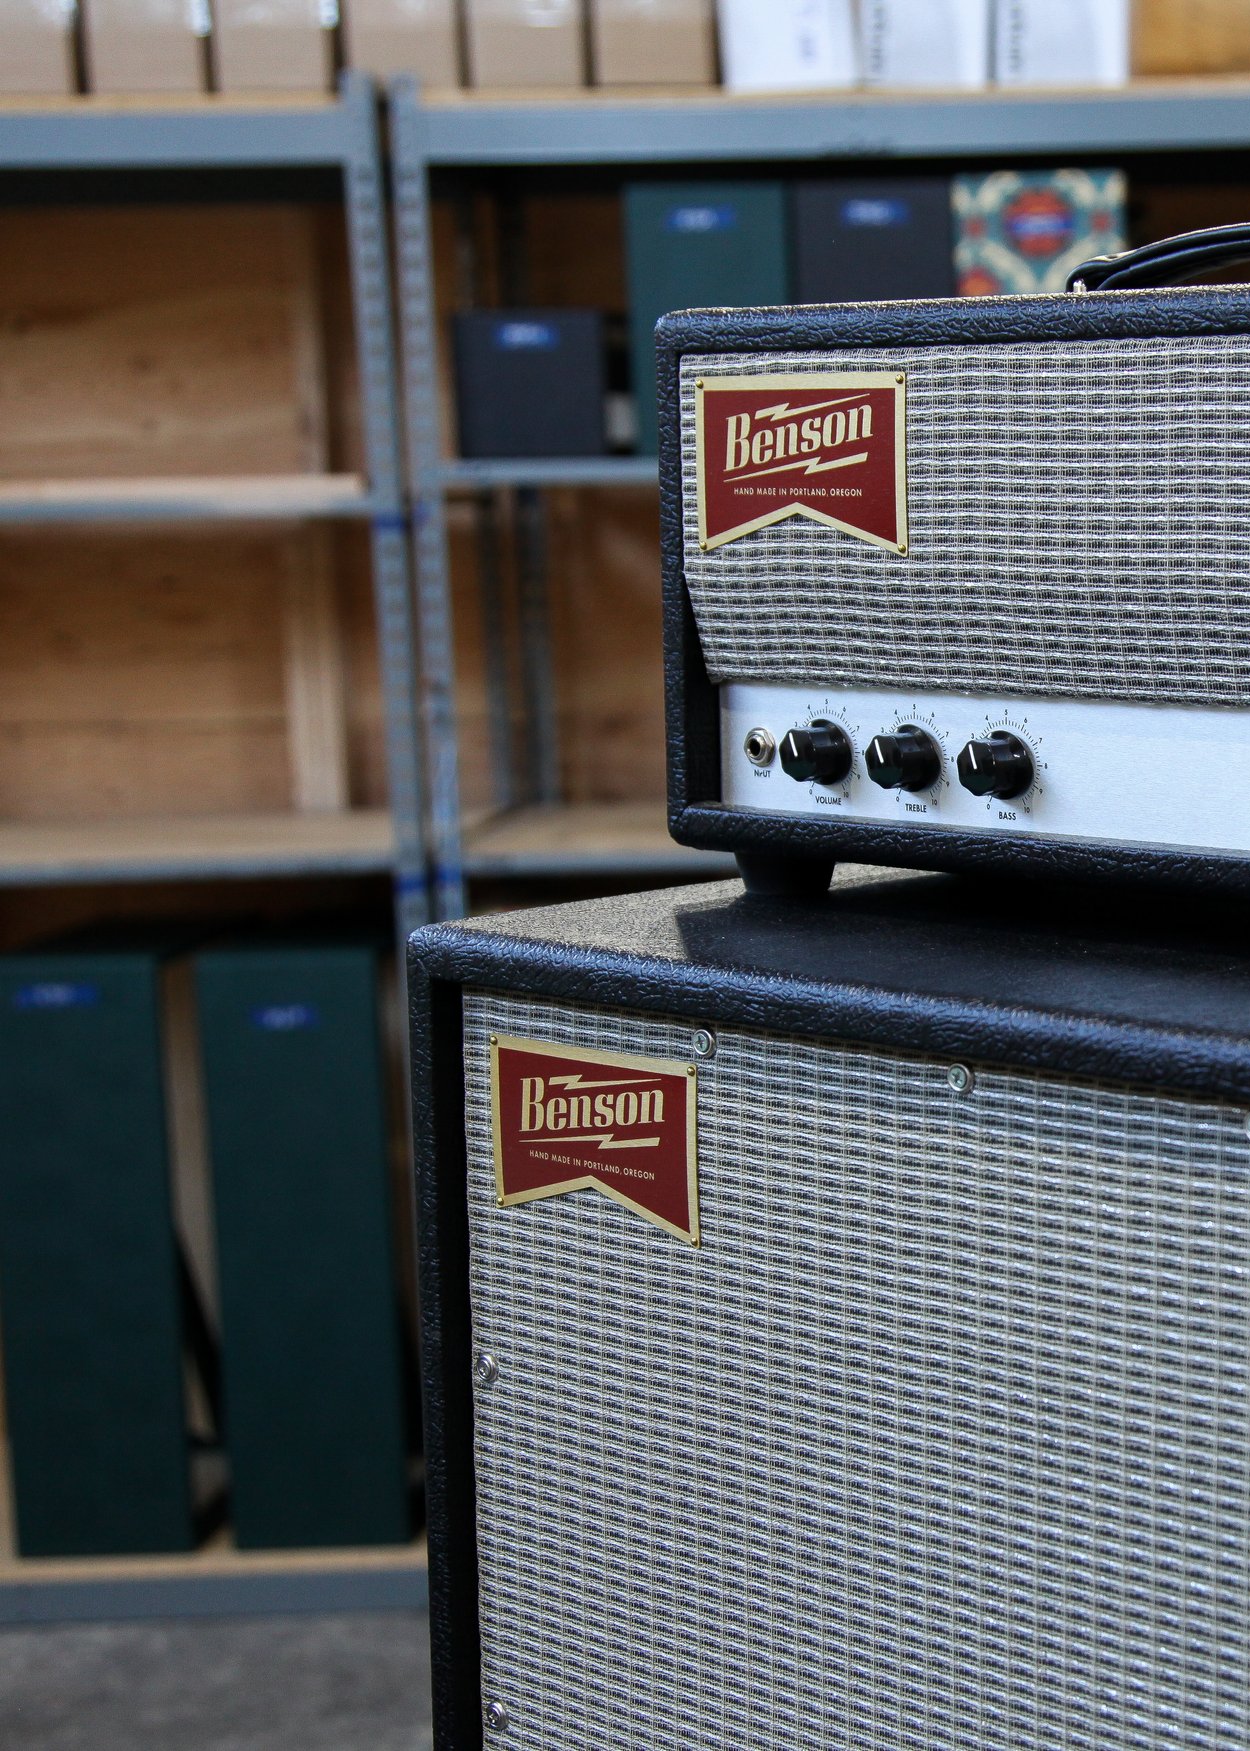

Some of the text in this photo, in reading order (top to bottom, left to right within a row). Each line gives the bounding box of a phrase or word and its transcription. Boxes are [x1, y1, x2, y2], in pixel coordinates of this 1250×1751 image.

[723, 404, 874, 472] Benson
[733, 487, 863, 497] HAND MADE IN PORTLAND, OREGON
[843, 791, 850, 799] 10
[815, 795, 842, 806] VOLUME
[905, 803, 928, 813] TREBLE
[1023, 806, 1031, 814] 10
[998, 811, 1017, 821] BASS
[518, 1077, 666, 1132] Benson
[529, 1149, 656, 1181] HAND MADE IN PORTLAND, OREGON
